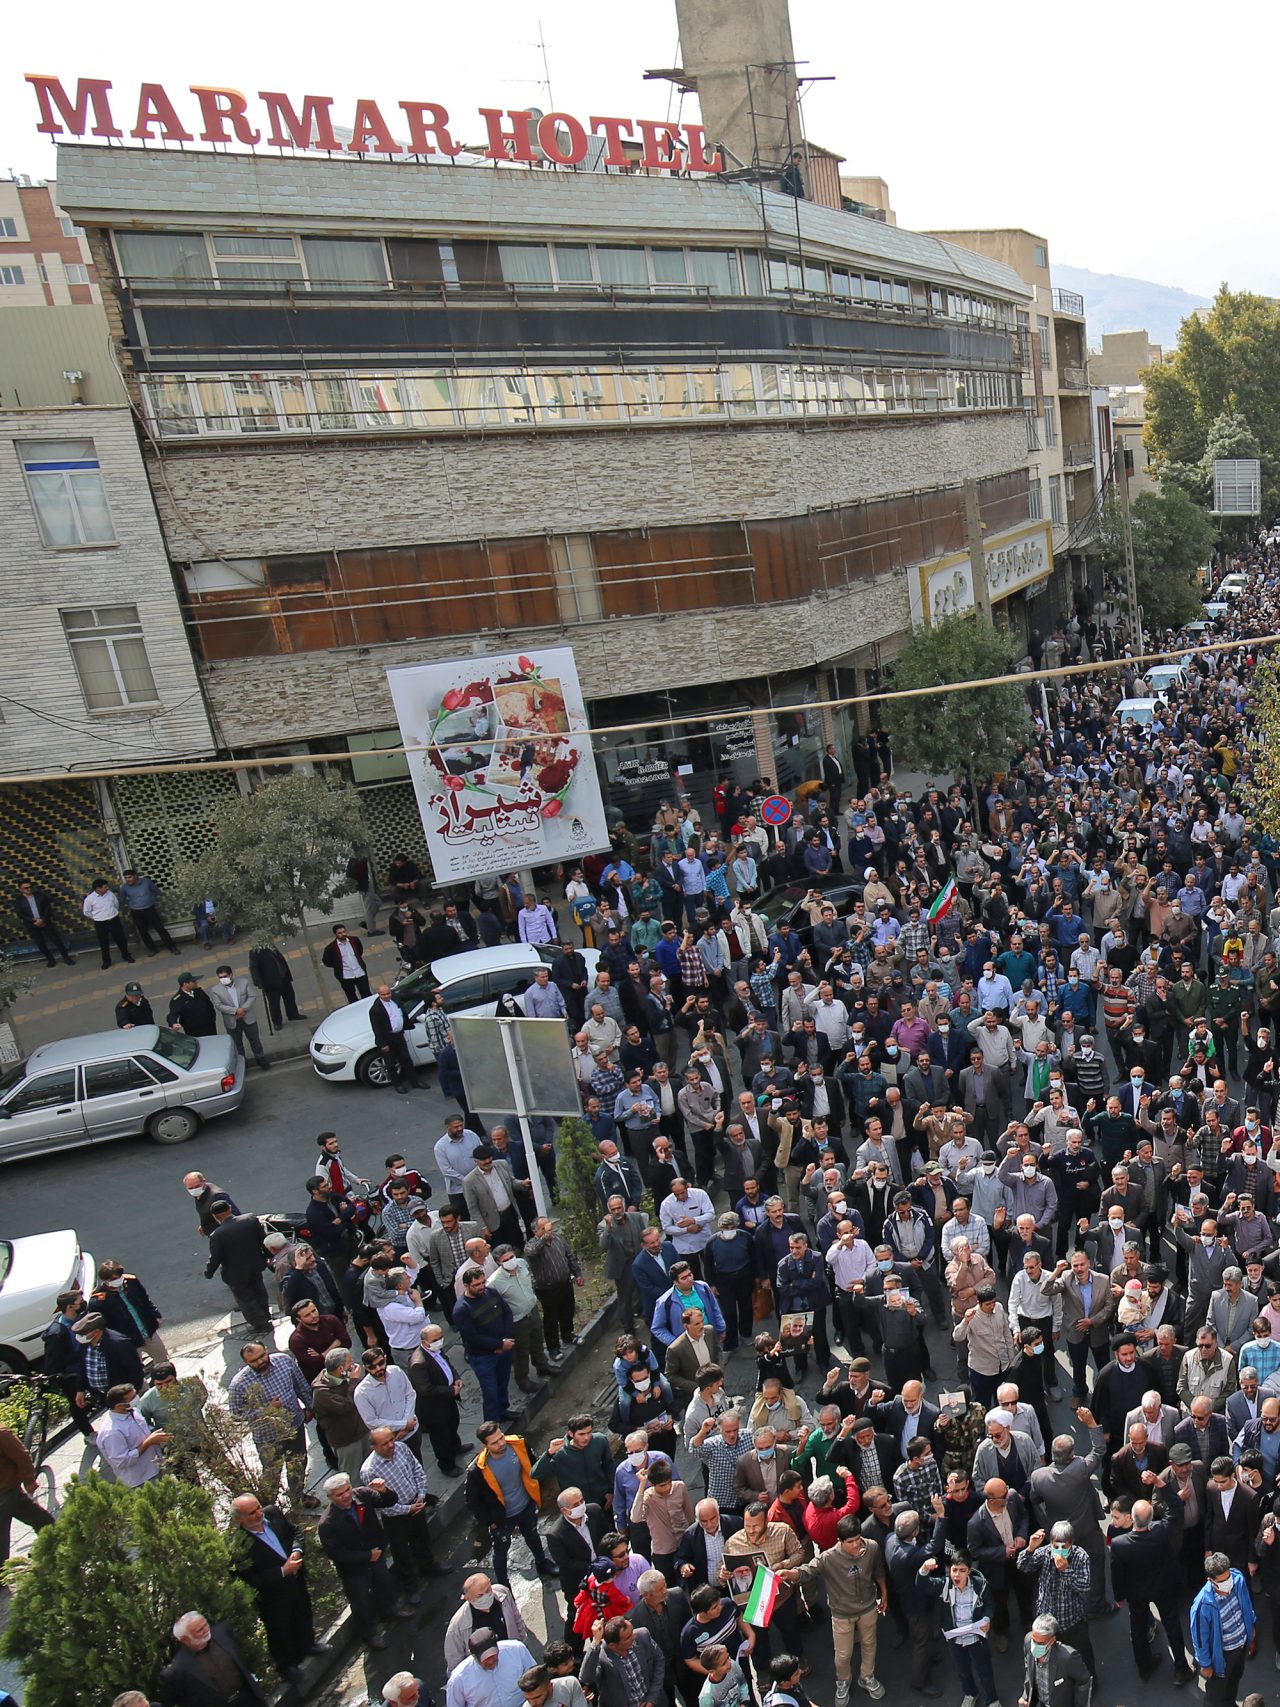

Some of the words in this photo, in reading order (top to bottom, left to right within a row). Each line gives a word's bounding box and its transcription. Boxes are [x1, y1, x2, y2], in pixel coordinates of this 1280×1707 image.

[23, 73, 461, 157] MARMAR
[478, 107, 724, 173] HOTEL
[435, 781, 542, 834] شیراز
[443, 807, 540, 847] تسلیت
